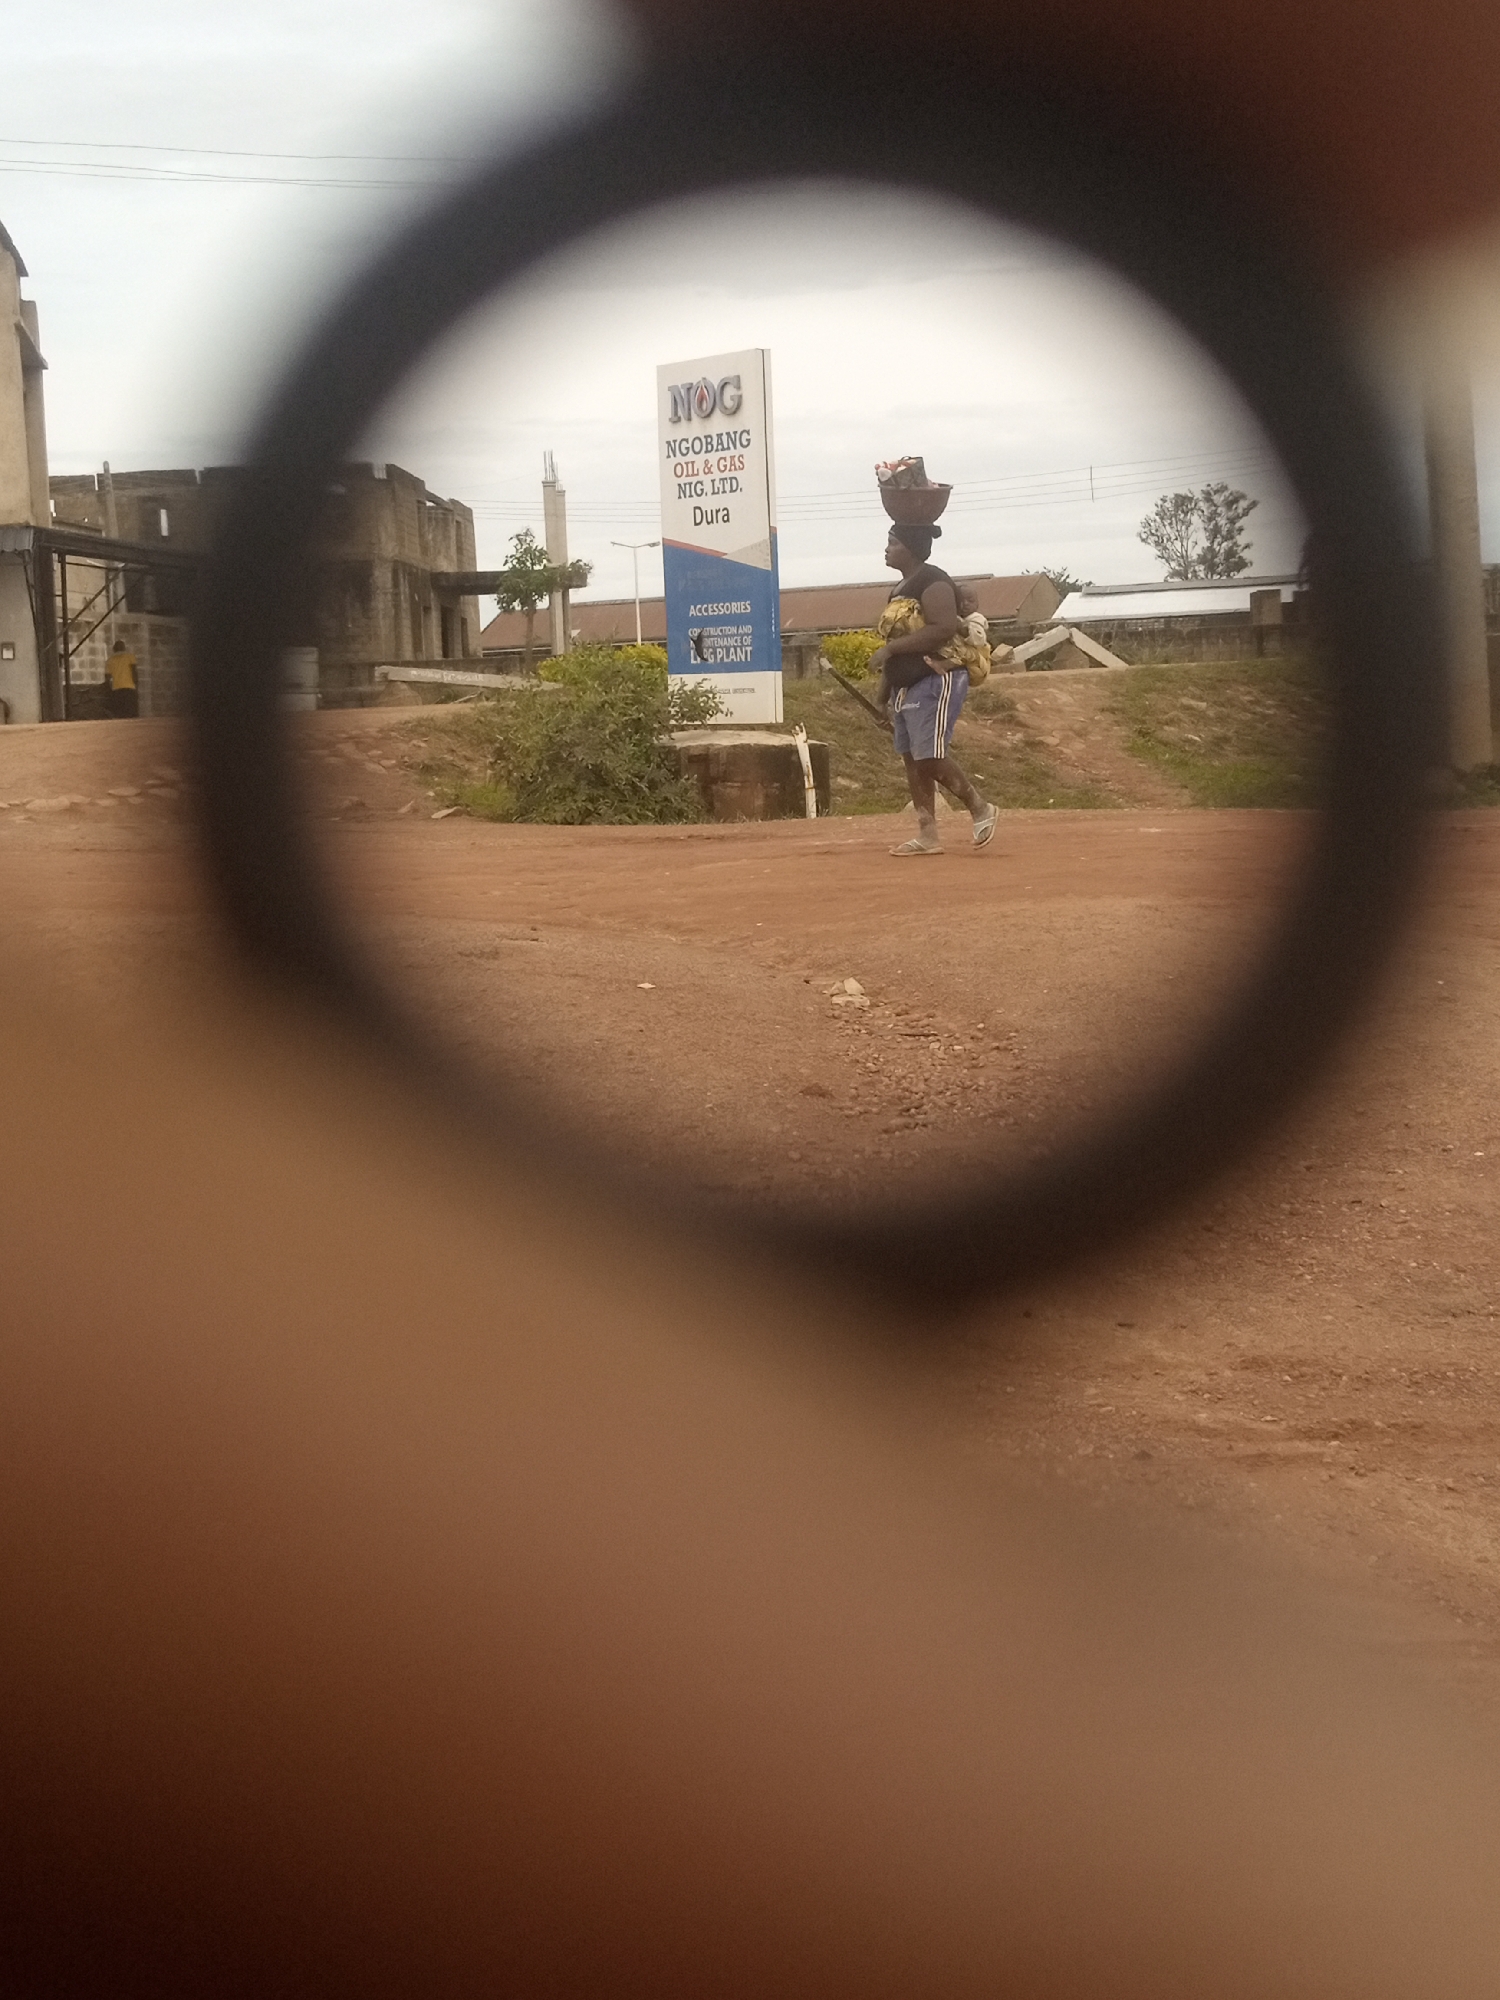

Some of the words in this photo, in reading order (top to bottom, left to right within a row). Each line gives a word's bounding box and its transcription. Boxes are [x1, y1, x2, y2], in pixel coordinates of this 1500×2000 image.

[668, 374, 743, 423] NOG
[666, 429, 751, 459] NGOBANG
[673, 460, 699, 478] OIL
[703, 458, 713, 475] &
[717, 454, 745, 474] GAS
[677, 480, 708, 499] NIG.
[711, 476, 743, 496] LTD.
[693, 506, 730, 526] Dura
[689, 601, 751, 617] ACCESSORIES
[738, 625, 753, 634] AND
[742, 636, 753, 646] OF
[716, 646, 753, 663] PLANT
